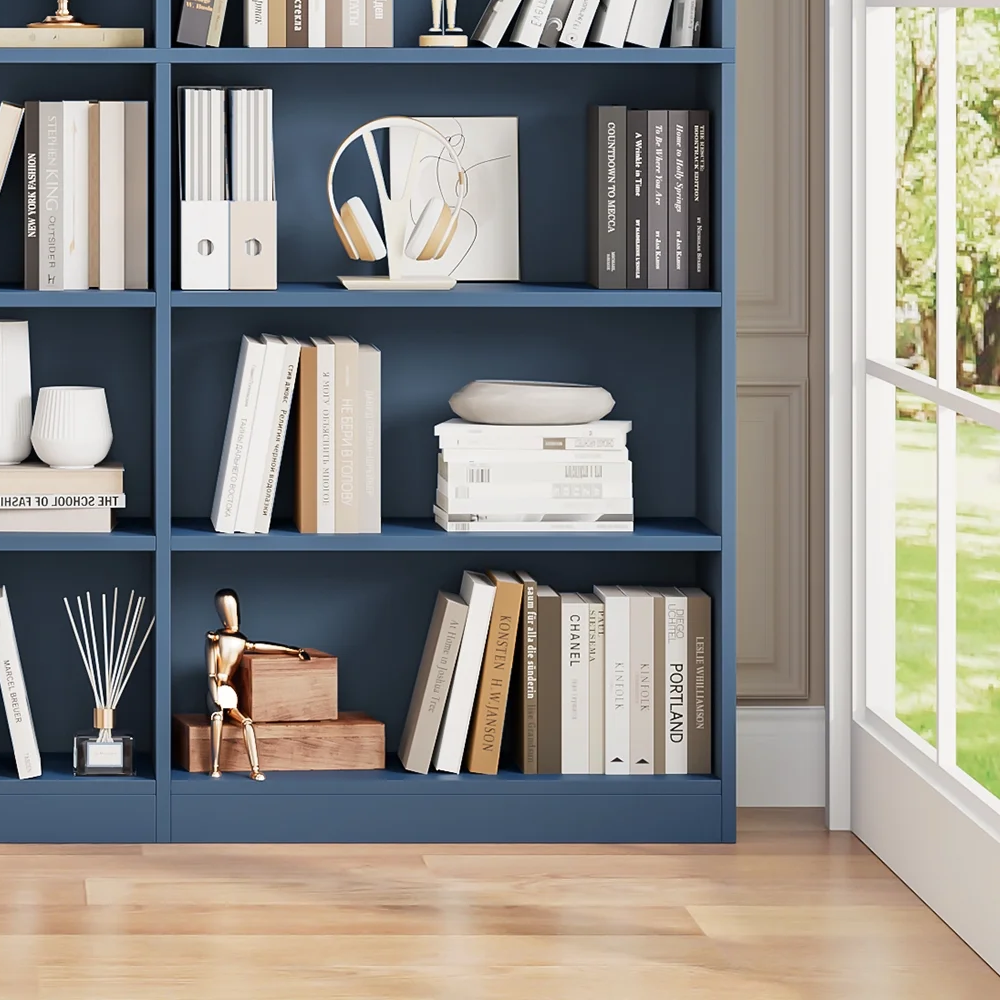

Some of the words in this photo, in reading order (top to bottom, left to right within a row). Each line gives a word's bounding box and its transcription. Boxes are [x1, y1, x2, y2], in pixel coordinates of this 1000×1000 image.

[47, 115, 57, 166] STEPHEN
[655, 124, 663, 135] To
[655, 135, 663, 147] Be
[675, 123, 683, 147] Home
[607, 121, 616, 184] COUNTDOWN
[635, 139, 643, 168] Wrinkle
[655, 148, 663, 173] Where
[676, 148, 683, 157] to
[27, 153, 36, 190] FASHION
[635, 169, 643, 177] in
[674, 158, 683, 180] Holly
[45, 168, 59, 211] KING
[607, 185, 616, 198] TO
[635, 177, 643, 197] Time
[655, 175, 663, 189] You
[27, 191, 36, 216] YORK
[655, 189, 663, 206] Are
[674, 181, 683, 213] Springs
[27, 217, 36, 238] NEW
[607, 199, 616, 233] MECCA
[48, 215, 56, 268] OUTSIDER
[322, 380, 330, 405] МОГУ
[341, 398, 354, 414] НЕ
[322, 408, 330, 465] ОБЪЯСНИТЬ
[341, 416, 354, 446] БЕРИ
[341, 448, 354, 457] В
[341, 459, 354, 506] ГОЛОВУ
[527, 586, 535, 609] saum
[527, 611, 537, 624] für
[668, 603, 676, 644] UCHITEL
[676, 608, 684, 639] DIEGO
[444, 632, 457, 655] Home
[527, 626, 537, 642] alla
[569, 614, 581, 667] CHANEL
[527, 644, 537, 658] die
[695, 636, 705, 664] LESLIE
[3, 659, 17, 689] MARCEL
[10, 692, 23, 724] BREUER
[434, 666, 447, 694] Joshua
[527, 660, 537, 699] sünderin
[614, 662, 624, 711] KINFOLK
[640, 662, 650, 712] KINFOLK
[428, 696, 439, 714] Tree
[670, 663, 684, 744] PORTLAND
